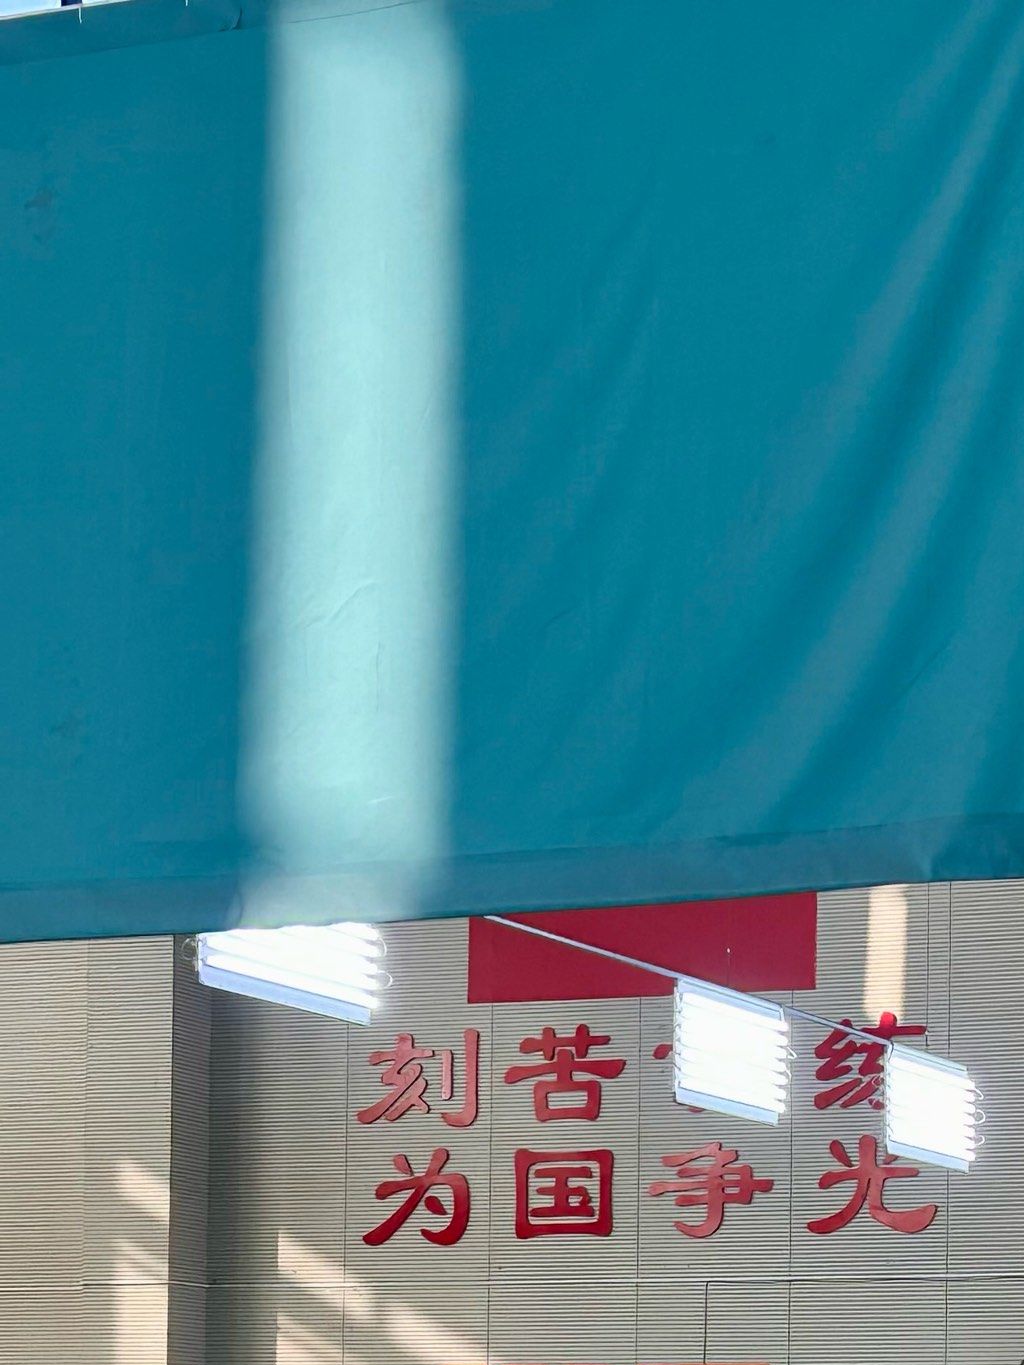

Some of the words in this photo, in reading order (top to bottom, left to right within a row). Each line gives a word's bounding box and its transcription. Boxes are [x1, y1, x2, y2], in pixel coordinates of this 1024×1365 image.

[357, 1012, 927, 1127] 刻苦练
[363, 1135, 937, 1246] 为国争光
